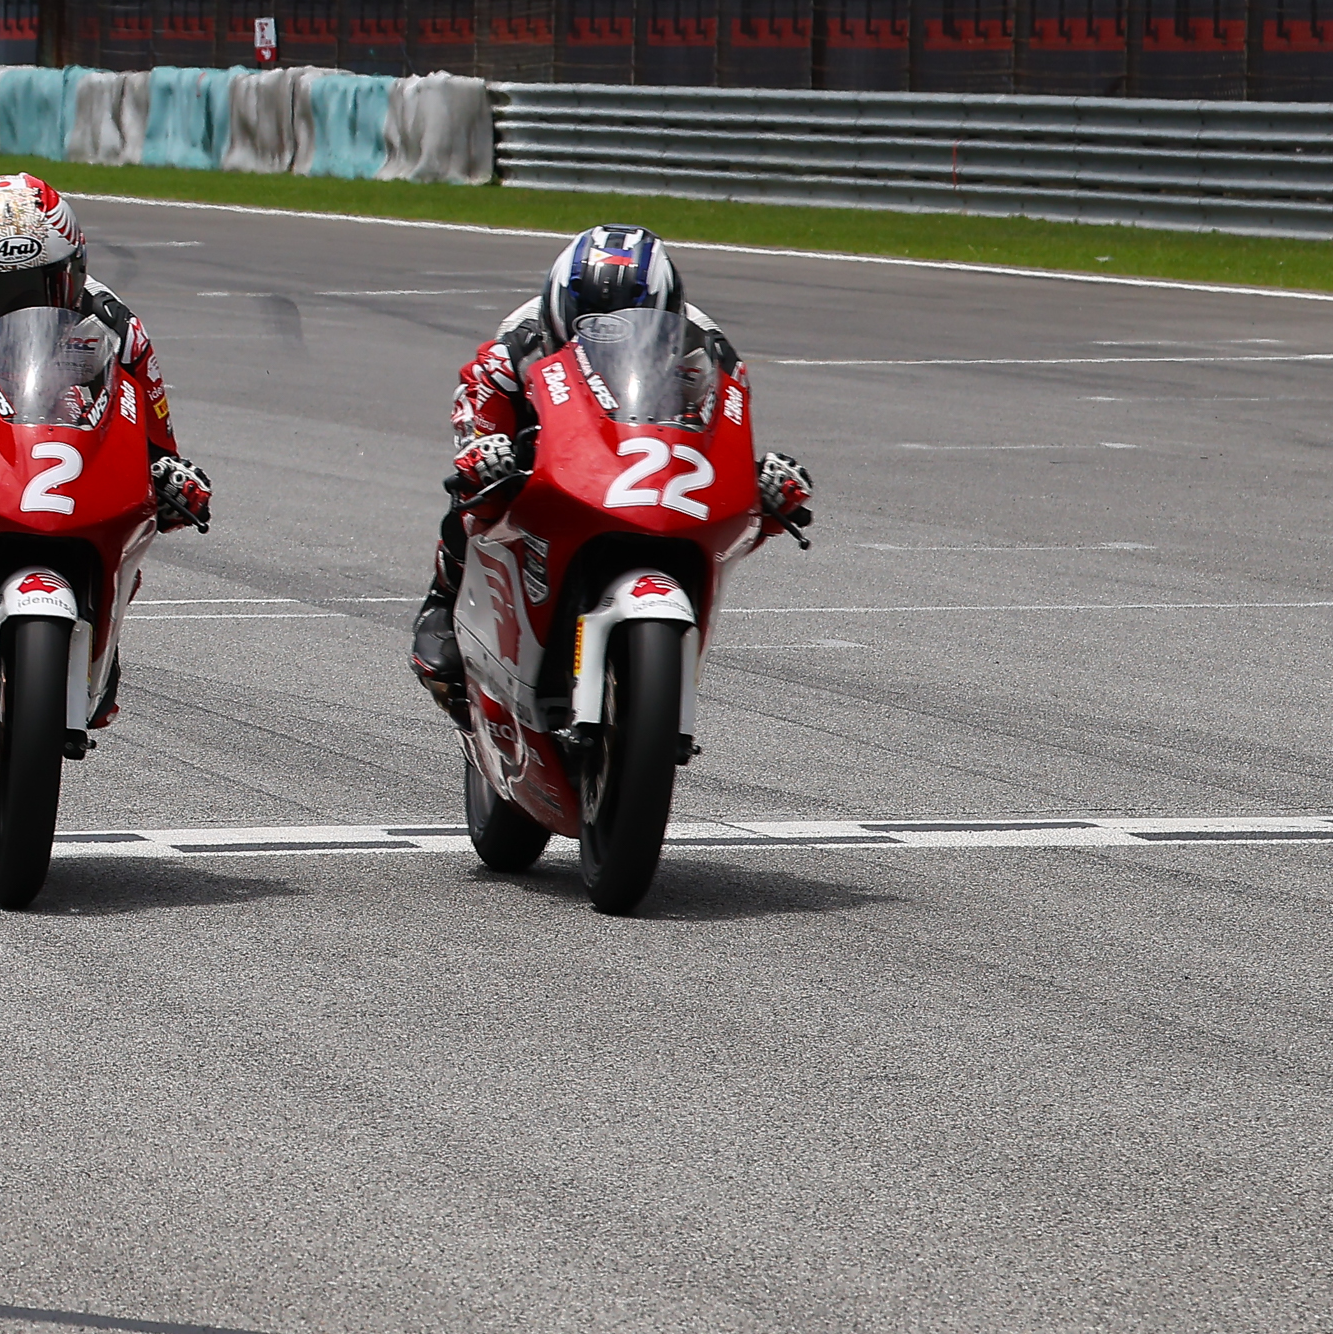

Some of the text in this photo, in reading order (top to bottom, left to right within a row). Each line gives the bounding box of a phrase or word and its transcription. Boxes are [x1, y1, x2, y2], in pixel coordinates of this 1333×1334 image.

[120, 380, 137, 417] Beta
[544, 370, 570, 405] Beta
[87, 388, 108, 427] WRS
[19, 441, 84, 515] 2
[602, 436, 715, 521] 22
[16, 595, 76, 616] idemitsu
[487, 721, 546, 767] HOA
